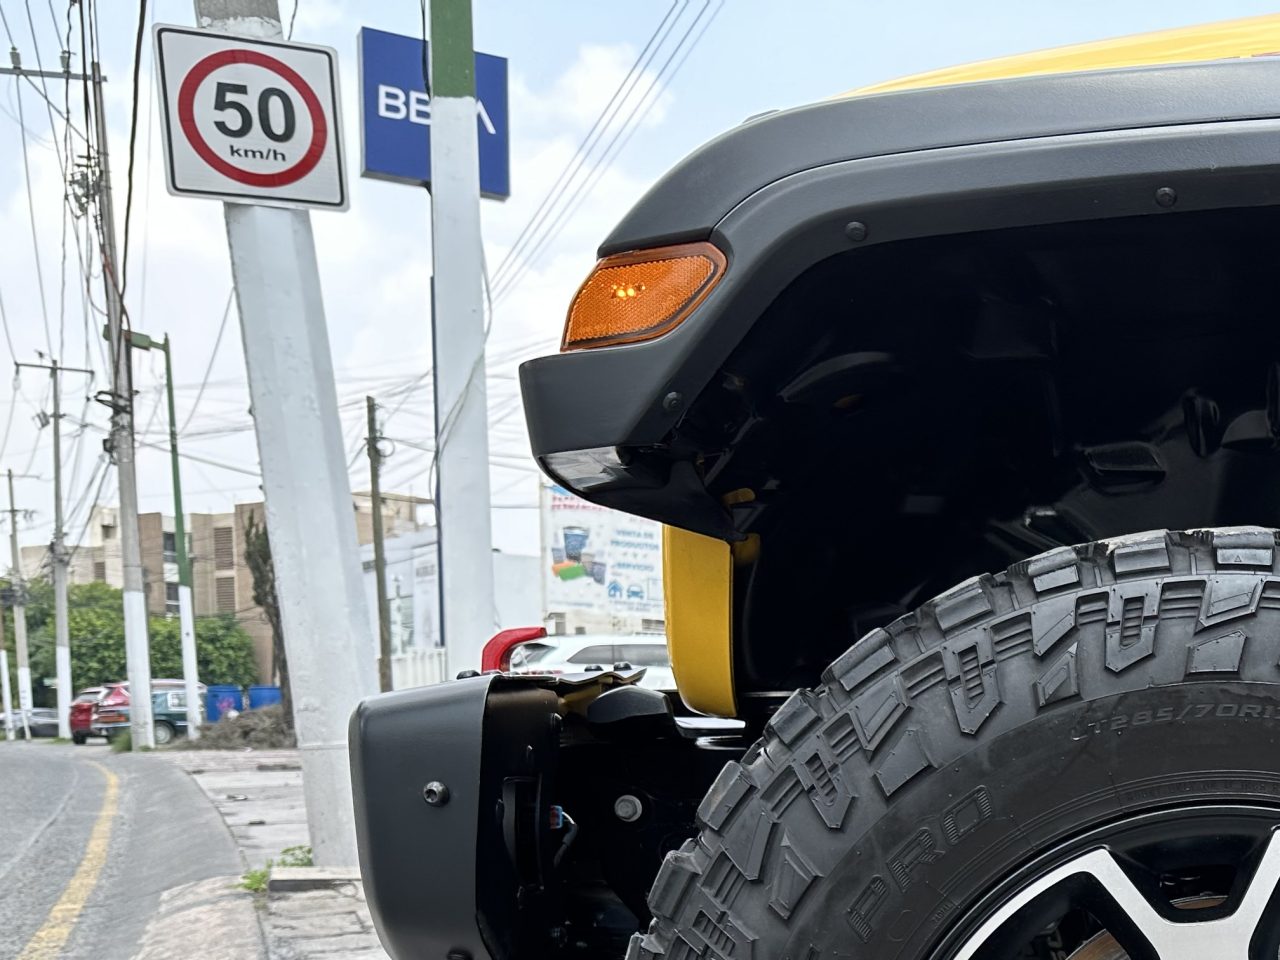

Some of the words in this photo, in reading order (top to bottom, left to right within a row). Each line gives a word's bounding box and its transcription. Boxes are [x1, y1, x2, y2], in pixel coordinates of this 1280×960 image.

[213, 81, 296, 143] 50
[378, 84, 496, 135] BBA
[229, 144, 286, 162] km/h
[844, 782, 998, 944] PRO
